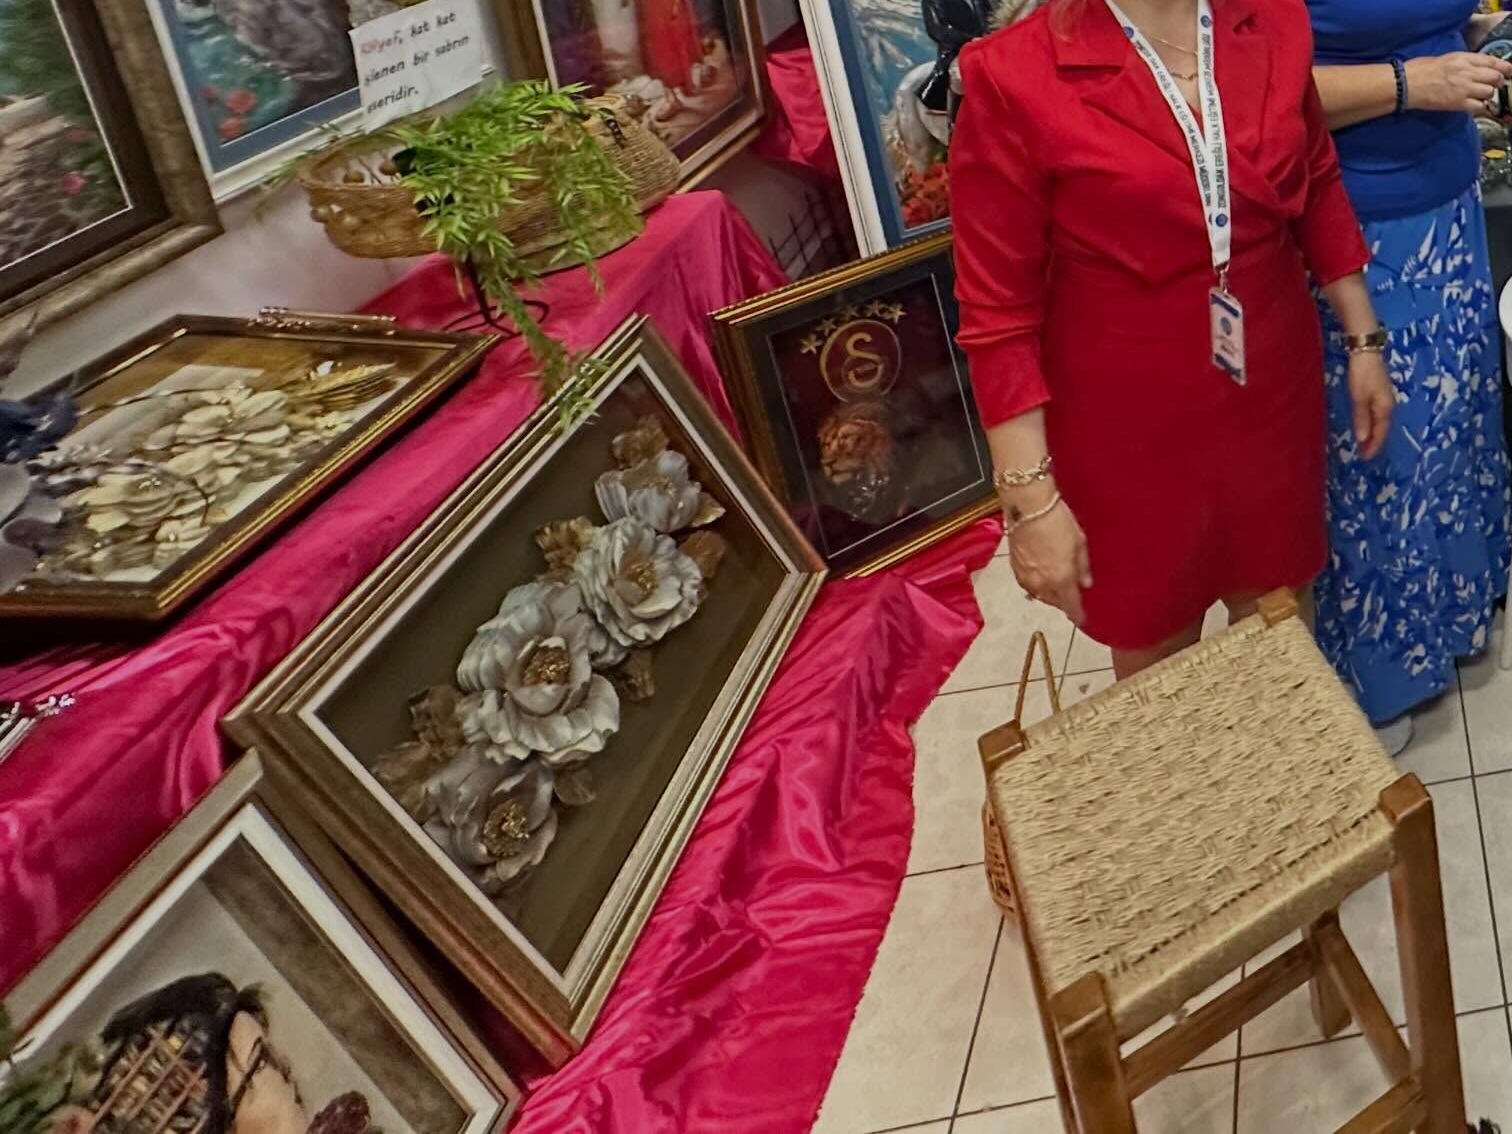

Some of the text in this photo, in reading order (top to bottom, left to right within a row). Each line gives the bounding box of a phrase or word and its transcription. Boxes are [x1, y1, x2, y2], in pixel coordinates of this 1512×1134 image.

[410, 21, 430, 37] kat
[436, 12, 456, 27] kat
[413, 51, 430, 66] bir
